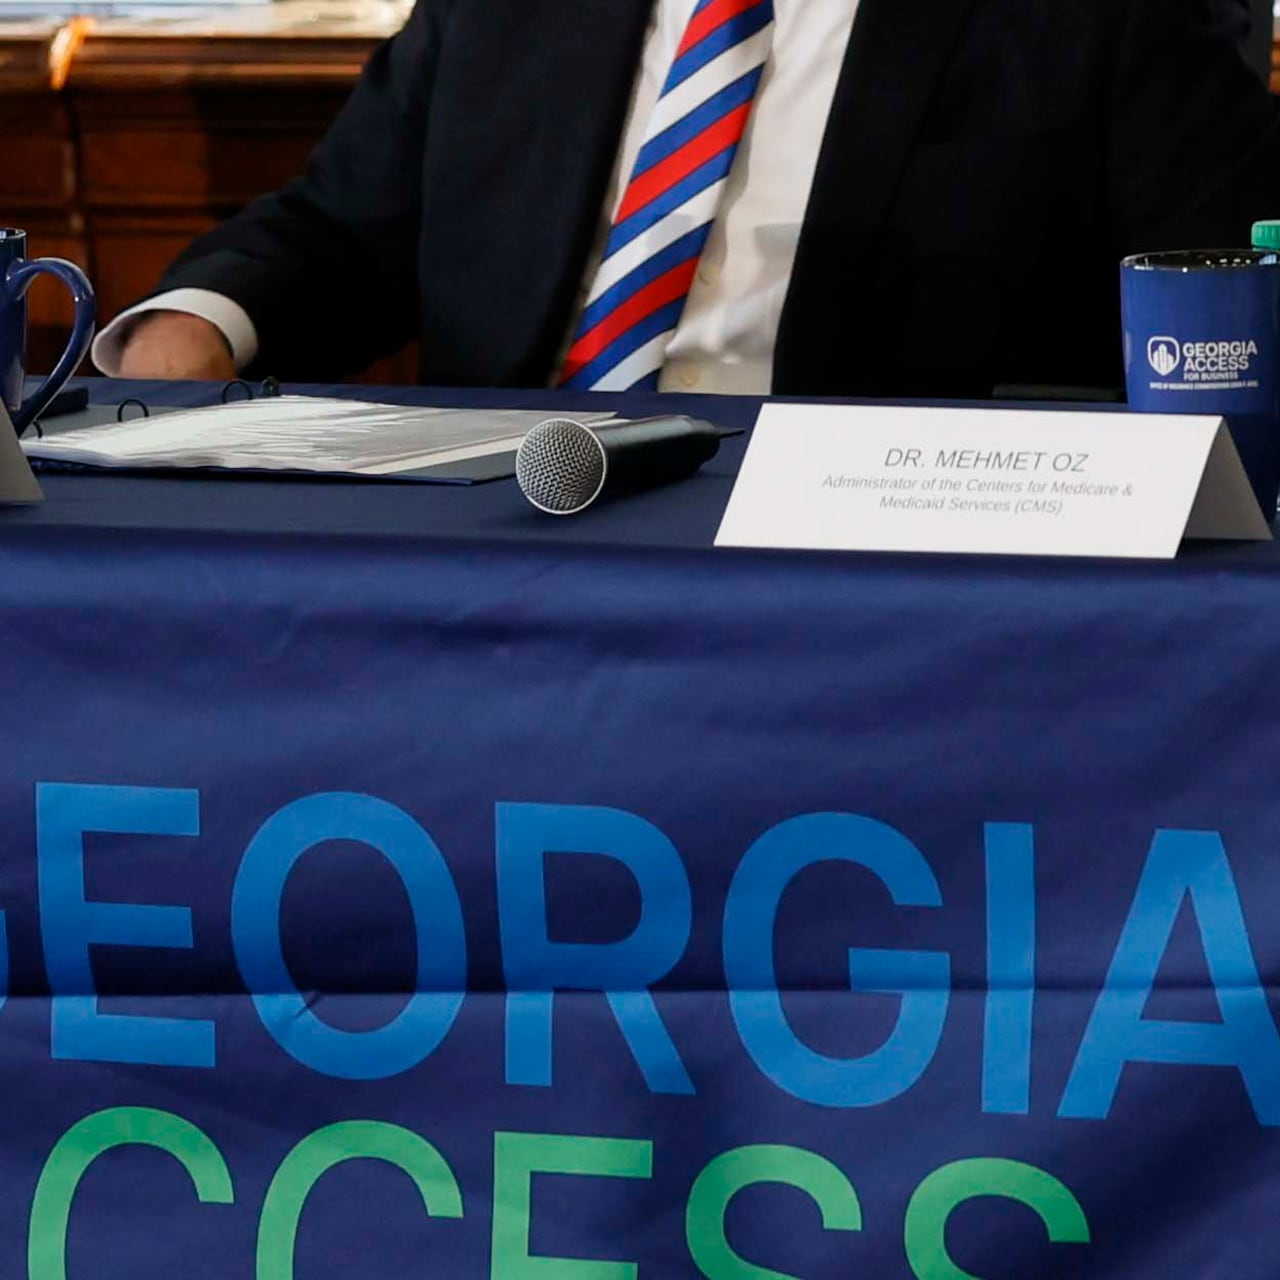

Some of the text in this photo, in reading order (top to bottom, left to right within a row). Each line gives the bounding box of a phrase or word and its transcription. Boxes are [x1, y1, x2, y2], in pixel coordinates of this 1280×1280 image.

[1182, 340, 1258, 357] GEORGIA
[1183, 356, 1249, 372] ACCESS
[884, 448, 1089, 472] DR. MEHMET OZ
[822, 475, 1134, 496] Administrator of the Centers for Medicare &
[879, 495, 1063, 515] Medicaid Services (CMS)
